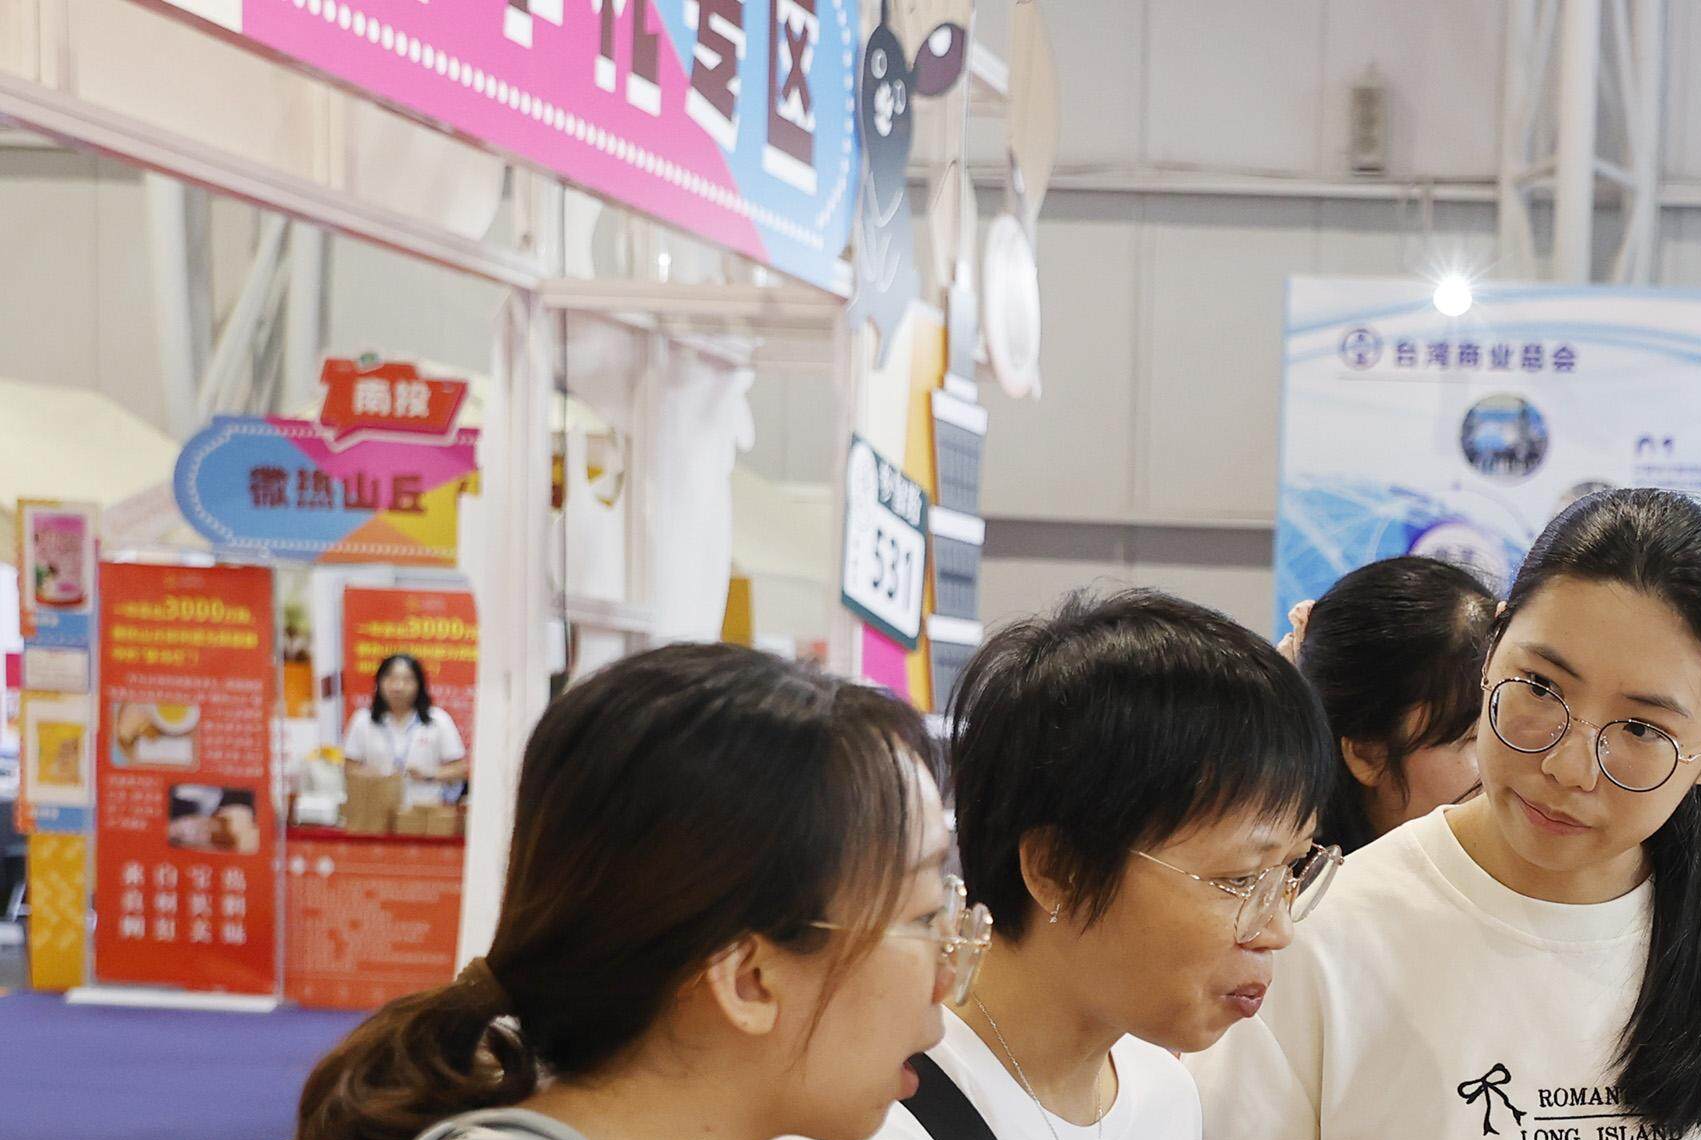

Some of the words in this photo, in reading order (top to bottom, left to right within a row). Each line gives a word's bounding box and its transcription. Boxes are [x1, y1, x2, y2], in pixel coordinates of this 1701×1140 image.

[1393, 341, 1577, 373] 台湾商业总会
[354, 379, 431, 417] 南投
[1538, 1086, 1621, 1107] ROMAN
